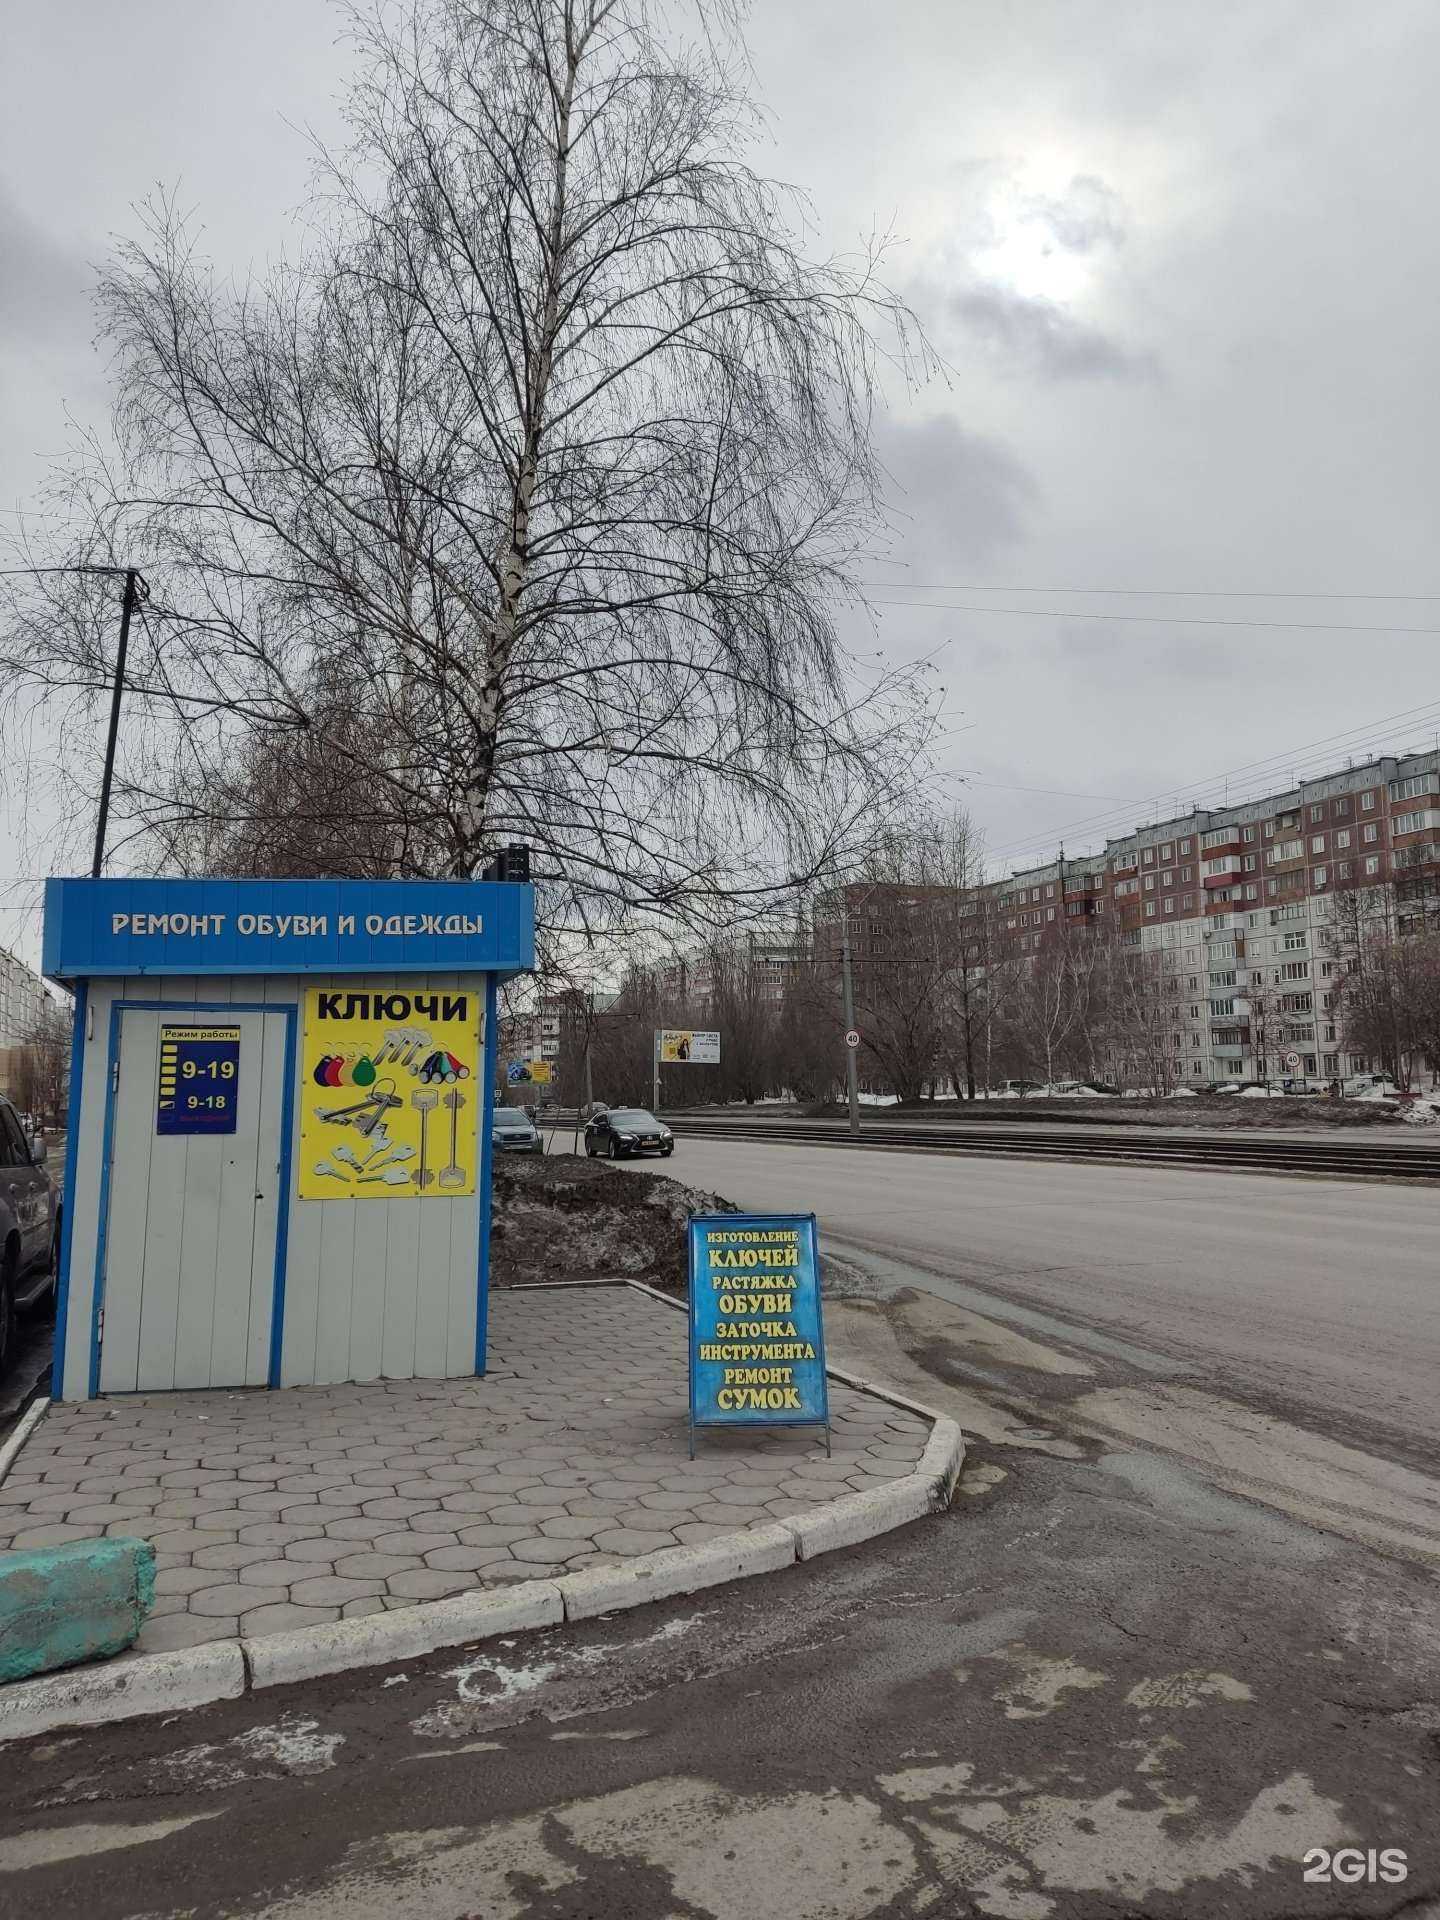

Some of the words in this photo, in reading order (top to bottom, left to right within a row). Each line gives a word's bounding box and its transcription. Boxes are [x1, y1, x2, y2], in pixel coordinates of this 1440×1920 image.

[112, 913, 226, 936] РЕМОНТ
[237, 914, 327, 937] ОБУВИ
[338, 915, 355, 935] И
[365, 914, 483, 935] ОДЕЖДЫ
[318, 993, 467, 1021] КЛЮЧИ
[165, 1030, 198, 1038] Режим
[201, 1030, 238, 1040] работы
[182, 1061, 235, 1079] 9-19
[187, 1096, 226, 1109] 9-18
[707, 1231, 799, 1243] ИЗГОТОВЛЕНИЕ
[708, 1244, 799, 1268] КЛЮЧЕЙ
[712, 1276, 797, 1290] РАСТЯЖКА
[719, 1294, 792, 1314] ОБУВИ
[716, 1321, 797, 1338] ЗАТОЧКА
[699, 1343, 816, 1361] ИНСТРУМЕНТА
[724, 1368, 793, 1385] РЕМОНТ
[717, 1388, 802, 1410] СУМОК
